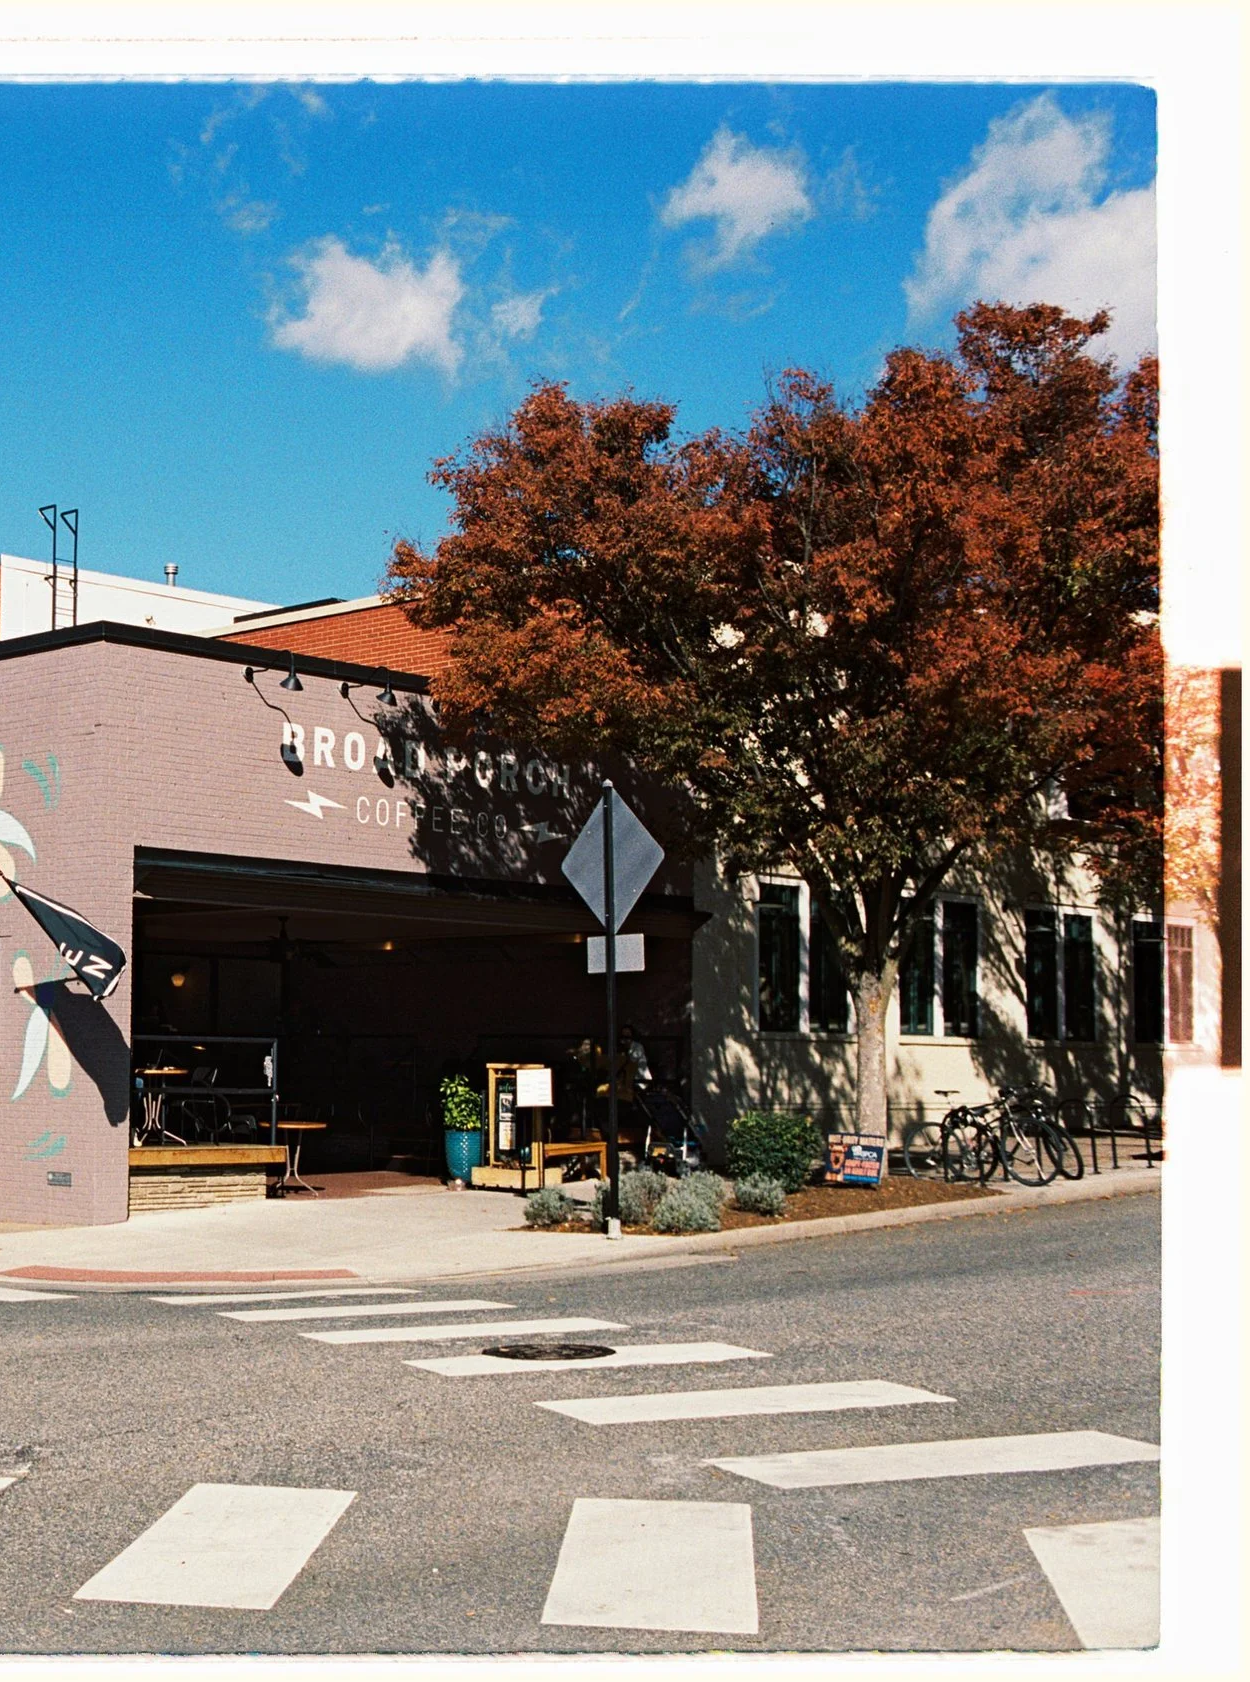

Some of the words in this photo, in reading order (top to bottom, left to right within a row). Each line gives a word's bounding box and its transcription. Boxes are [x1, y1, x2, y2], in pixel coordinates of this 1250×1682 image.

[283, 721, 426, 779] BROAD
[445, 747, 570, 799] PORCH
[356, 796, 464, 836] COFFEE
